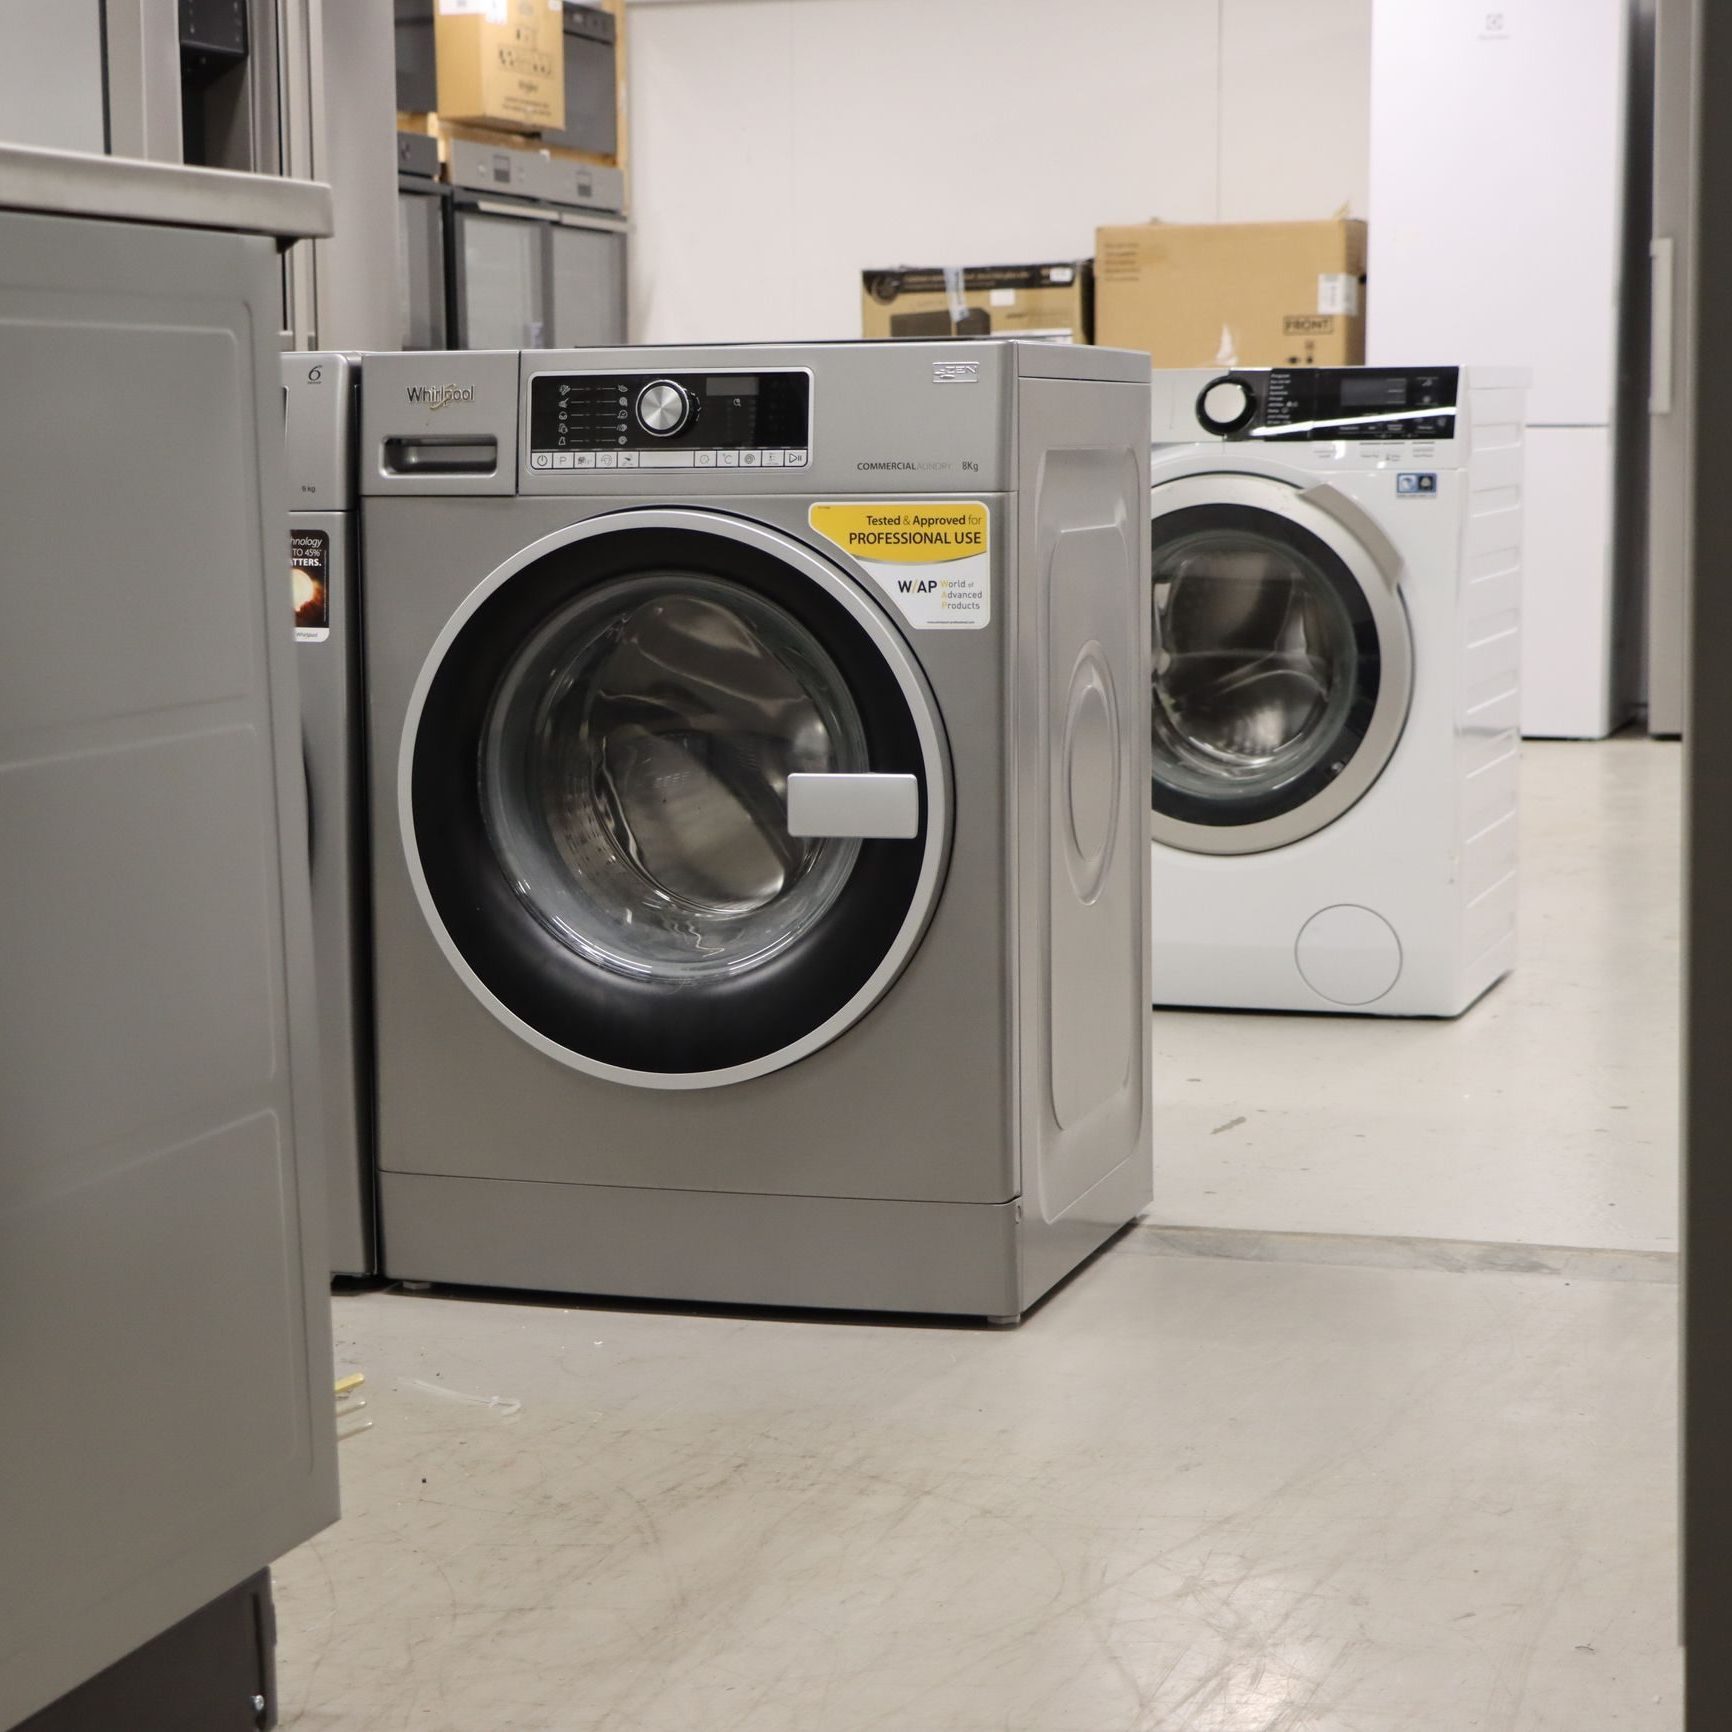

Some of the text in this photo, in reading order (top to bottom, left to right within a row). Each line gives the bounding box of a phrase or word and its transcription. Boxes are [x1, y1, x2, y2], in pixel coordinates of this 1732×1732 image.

[1285, 319, 1329, 331] FRONT
[407, 385, 475, 410] Whirlpool
[961, 462, 979, 472] 8Kg
[866, 515, 982, 528] Tested & Approved for
[849, 532, 982, 545] PROFESSIONAL USE
[940, 580, 966, 588] World
[941, 591, 983, 599] Advanced
[941, 602, 981, 610] Products
